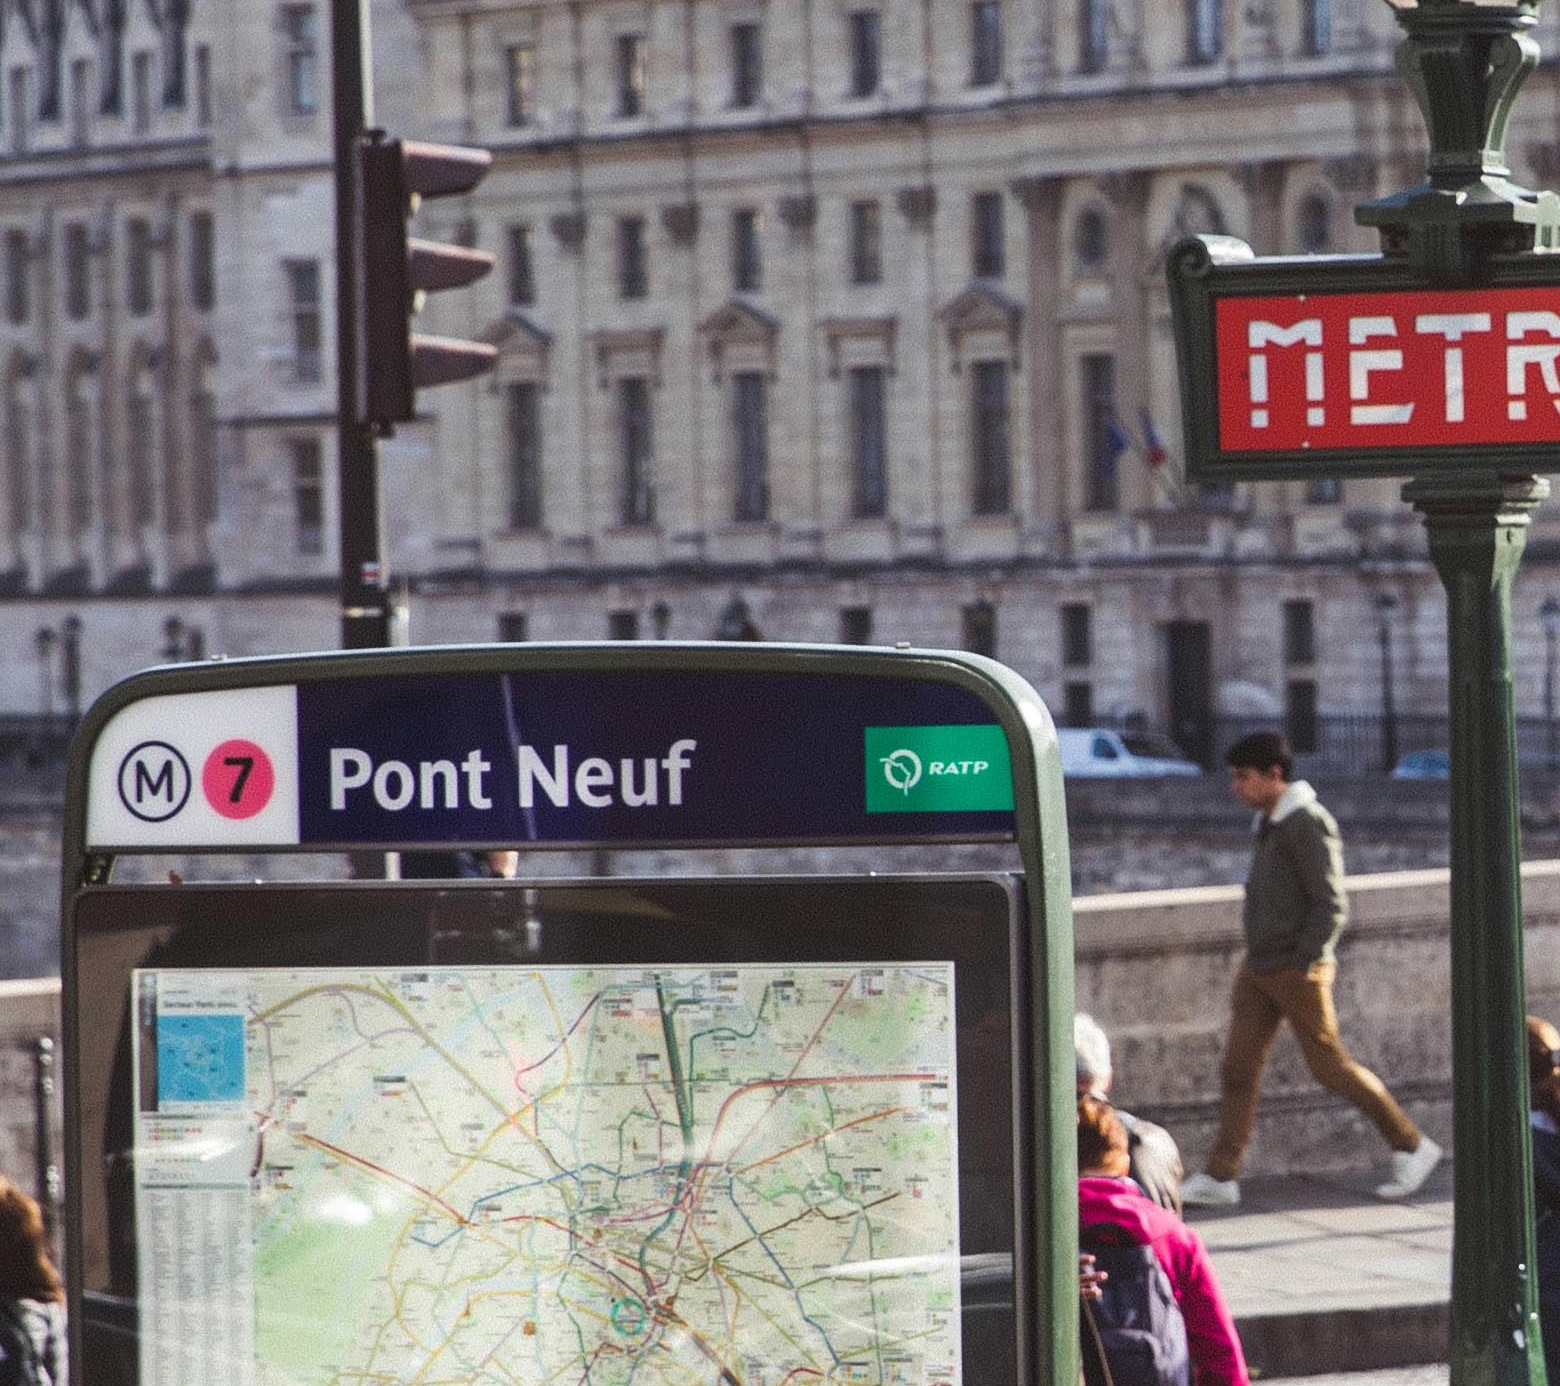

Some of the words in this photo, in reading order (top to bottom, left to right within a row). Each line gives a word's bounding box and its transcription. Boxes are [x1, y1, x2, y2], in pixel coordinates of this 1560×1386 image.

[135, 758, 174, 804] M
[223, 756, 254, 804] 7
[328, 746, 493, 812] Pont
[518, 738, 698, 809] Neuf
[928, 760, 990, 776] RATP
